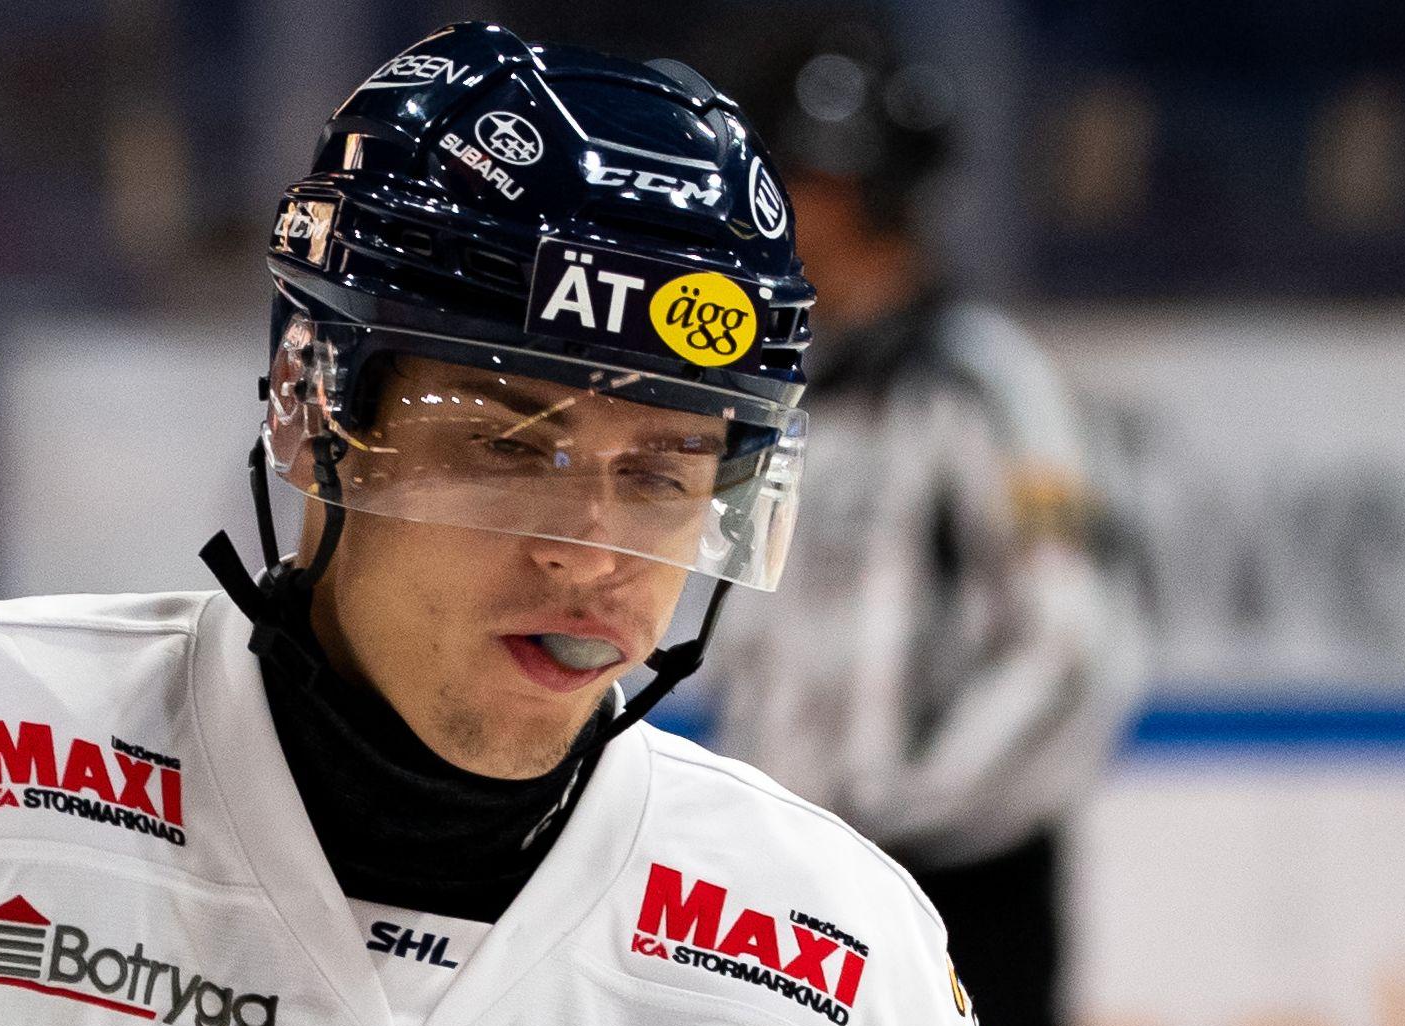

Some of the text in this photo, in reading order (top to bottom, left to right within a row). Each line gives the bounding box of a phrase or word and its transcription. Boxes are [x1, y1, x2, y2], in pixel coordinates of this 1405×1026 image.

[438, 132, 524, 201] SUBARU
[585, 166, 723, 207] CCM
[540, 250, 749, 356] ÄT ägg
[23, 788, 186, 847] STORMARKNAD
[366, 920, 459, 969] SHL
[631, 933, 669, 961] ICA
[636, 862, 866, 1008] MAXI
[789, 909, 870, 958] LINKÖPING
